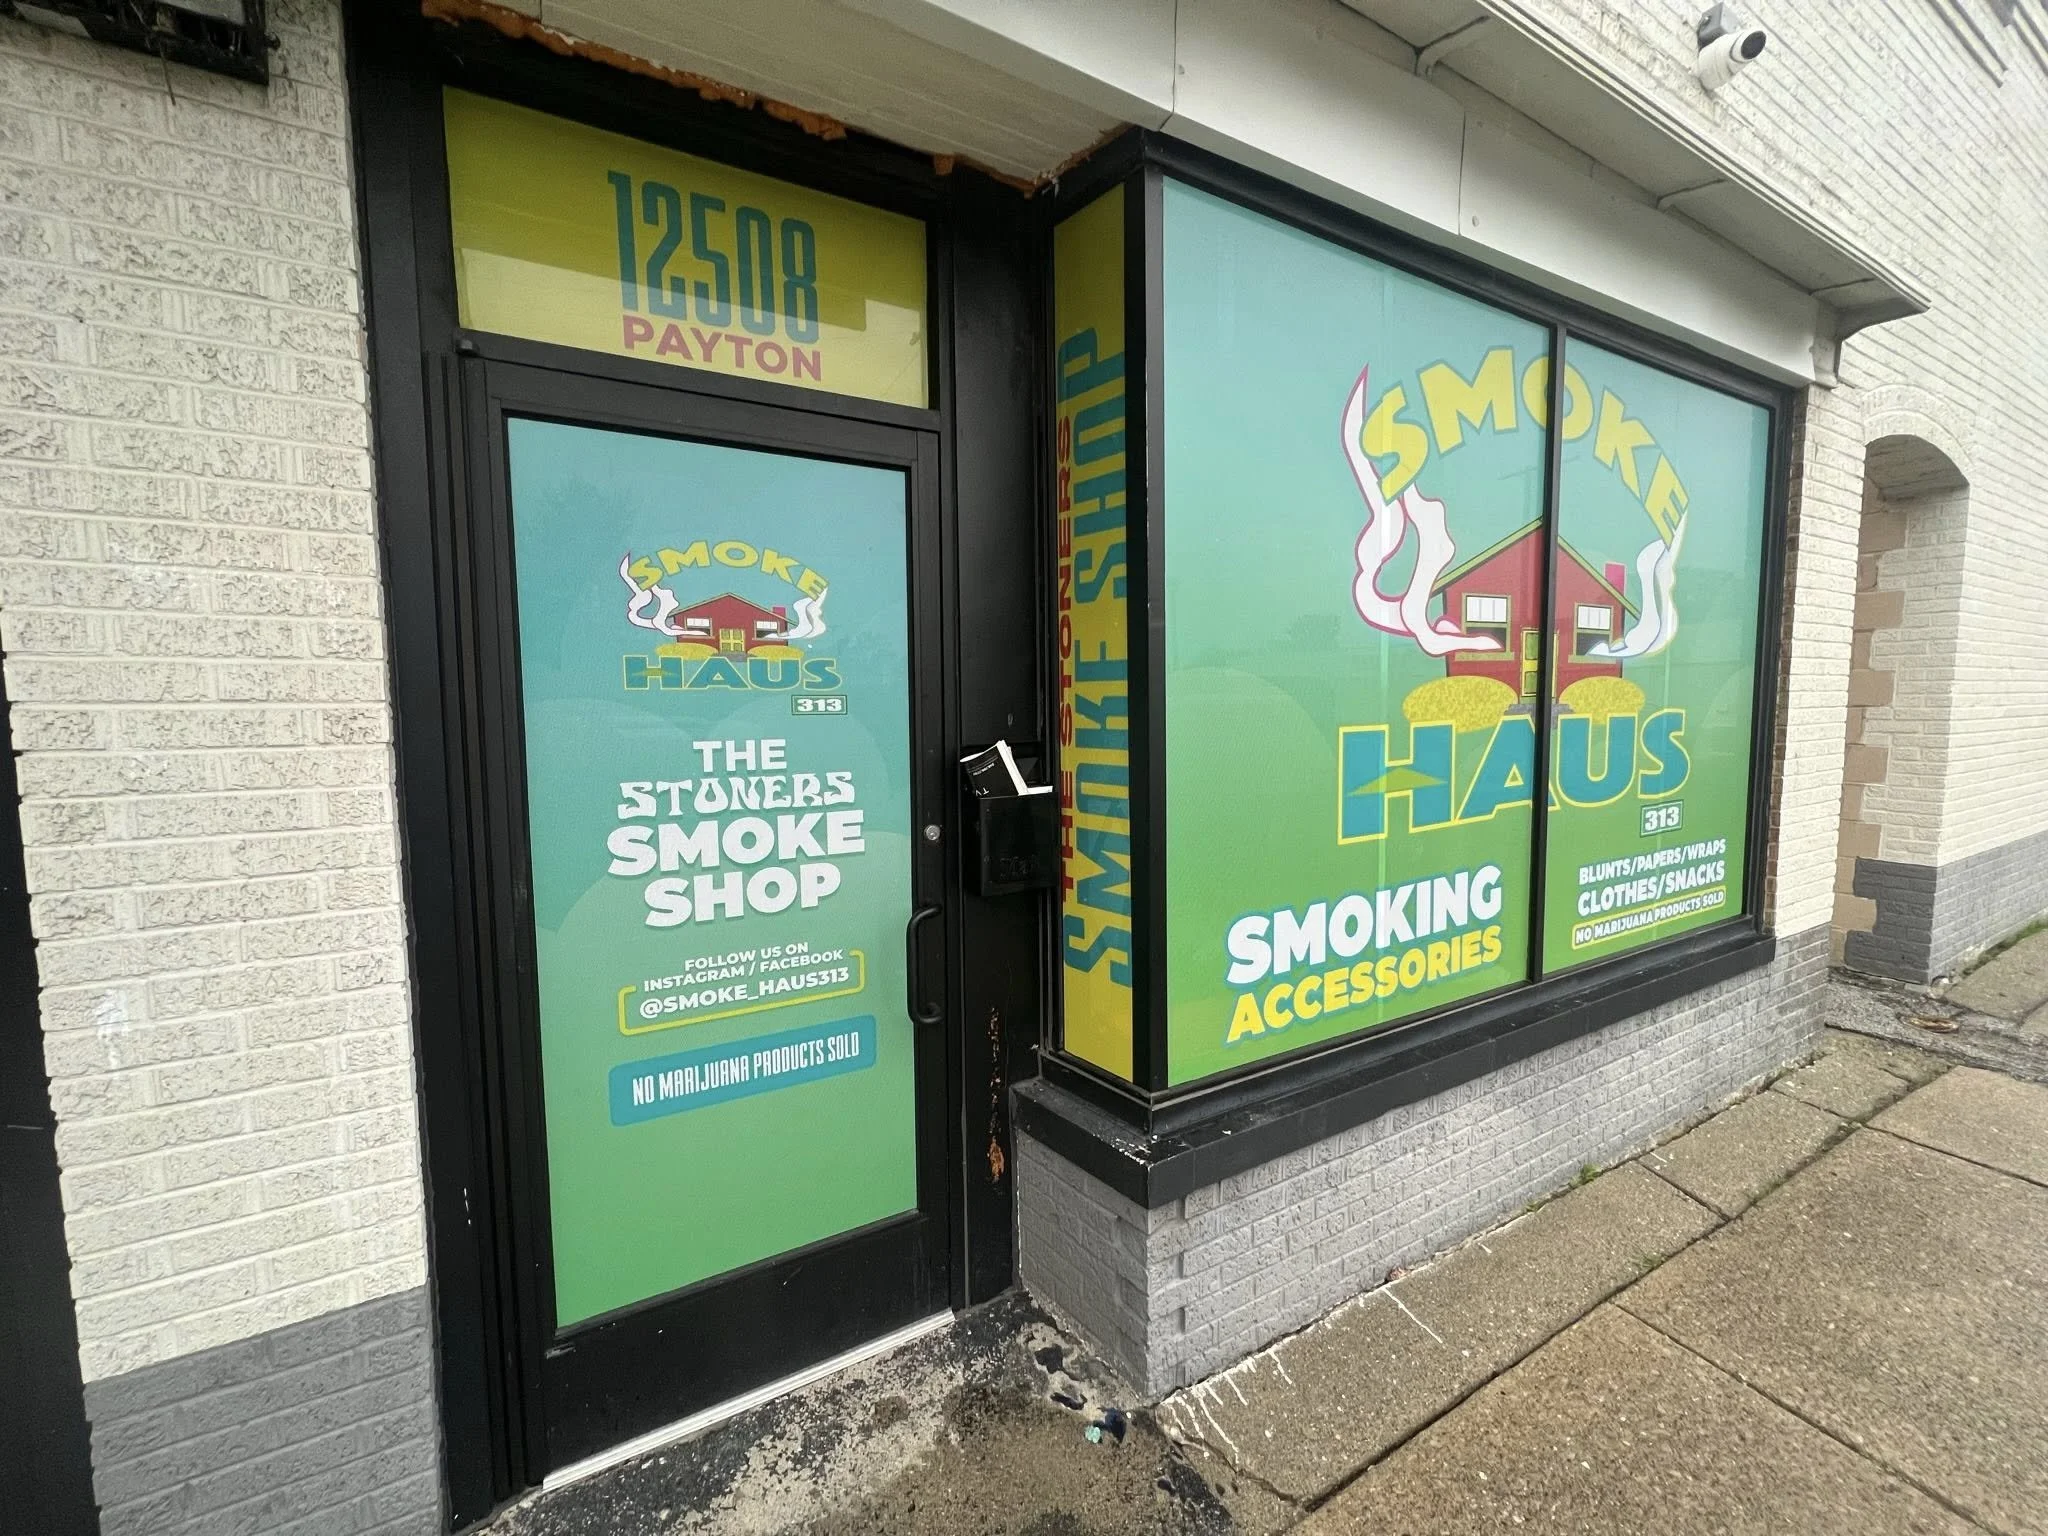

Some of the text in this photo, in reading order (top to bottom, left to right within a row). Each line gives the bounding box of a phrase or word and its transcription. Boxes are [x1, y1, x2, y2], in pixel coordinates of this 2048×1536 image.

[608, 170, 820, 345] 12508
[622, 314, 823, 383] PAYTON
[1359, 345, 1690, 551] SMOKE
[627, 539, 830, 602] SMOKE
[623, 655, 842, 691] HAUS
[1057, 327, 1132, 989] SMOKE SHOP
[1057, 415, 1075, 903] THE STONERS
[797, 698, 842, 713] 313
[692, 738, 788, 773] THE
[1336, 708, 1692, 846] HAUS
[617, 771, 856, 820] STONERS
[1644, 806, 1681, 832] 313
[606, 809, 866, 876] SMOKE
[1578, 838, 1727, 886] BLUNTS/PAPERS/WRAPS
[644, 862, 842, 928] SHOP
[1574, 891, 1725, 945] NO MARIJUANA PRODUCTS SOLD
[1577, 860, 1725, 917] CLOTHES/SNACKS
[684, 941, 809, 972] FOLLOW US ON
[1226, 865, 1503, 985] SMOKING
[638, 967, 850, 1019] @SMOKE_HAUS313
[643, 966, 746, 993] INSTAGRAM
[759, 949, 844, 973] FACEBOOK
[1226, 924, 1503, 1043] ACCESSORIES
[632, 1031, 861, 1107] NO MARIJUANA PRODUCTS SOLD
